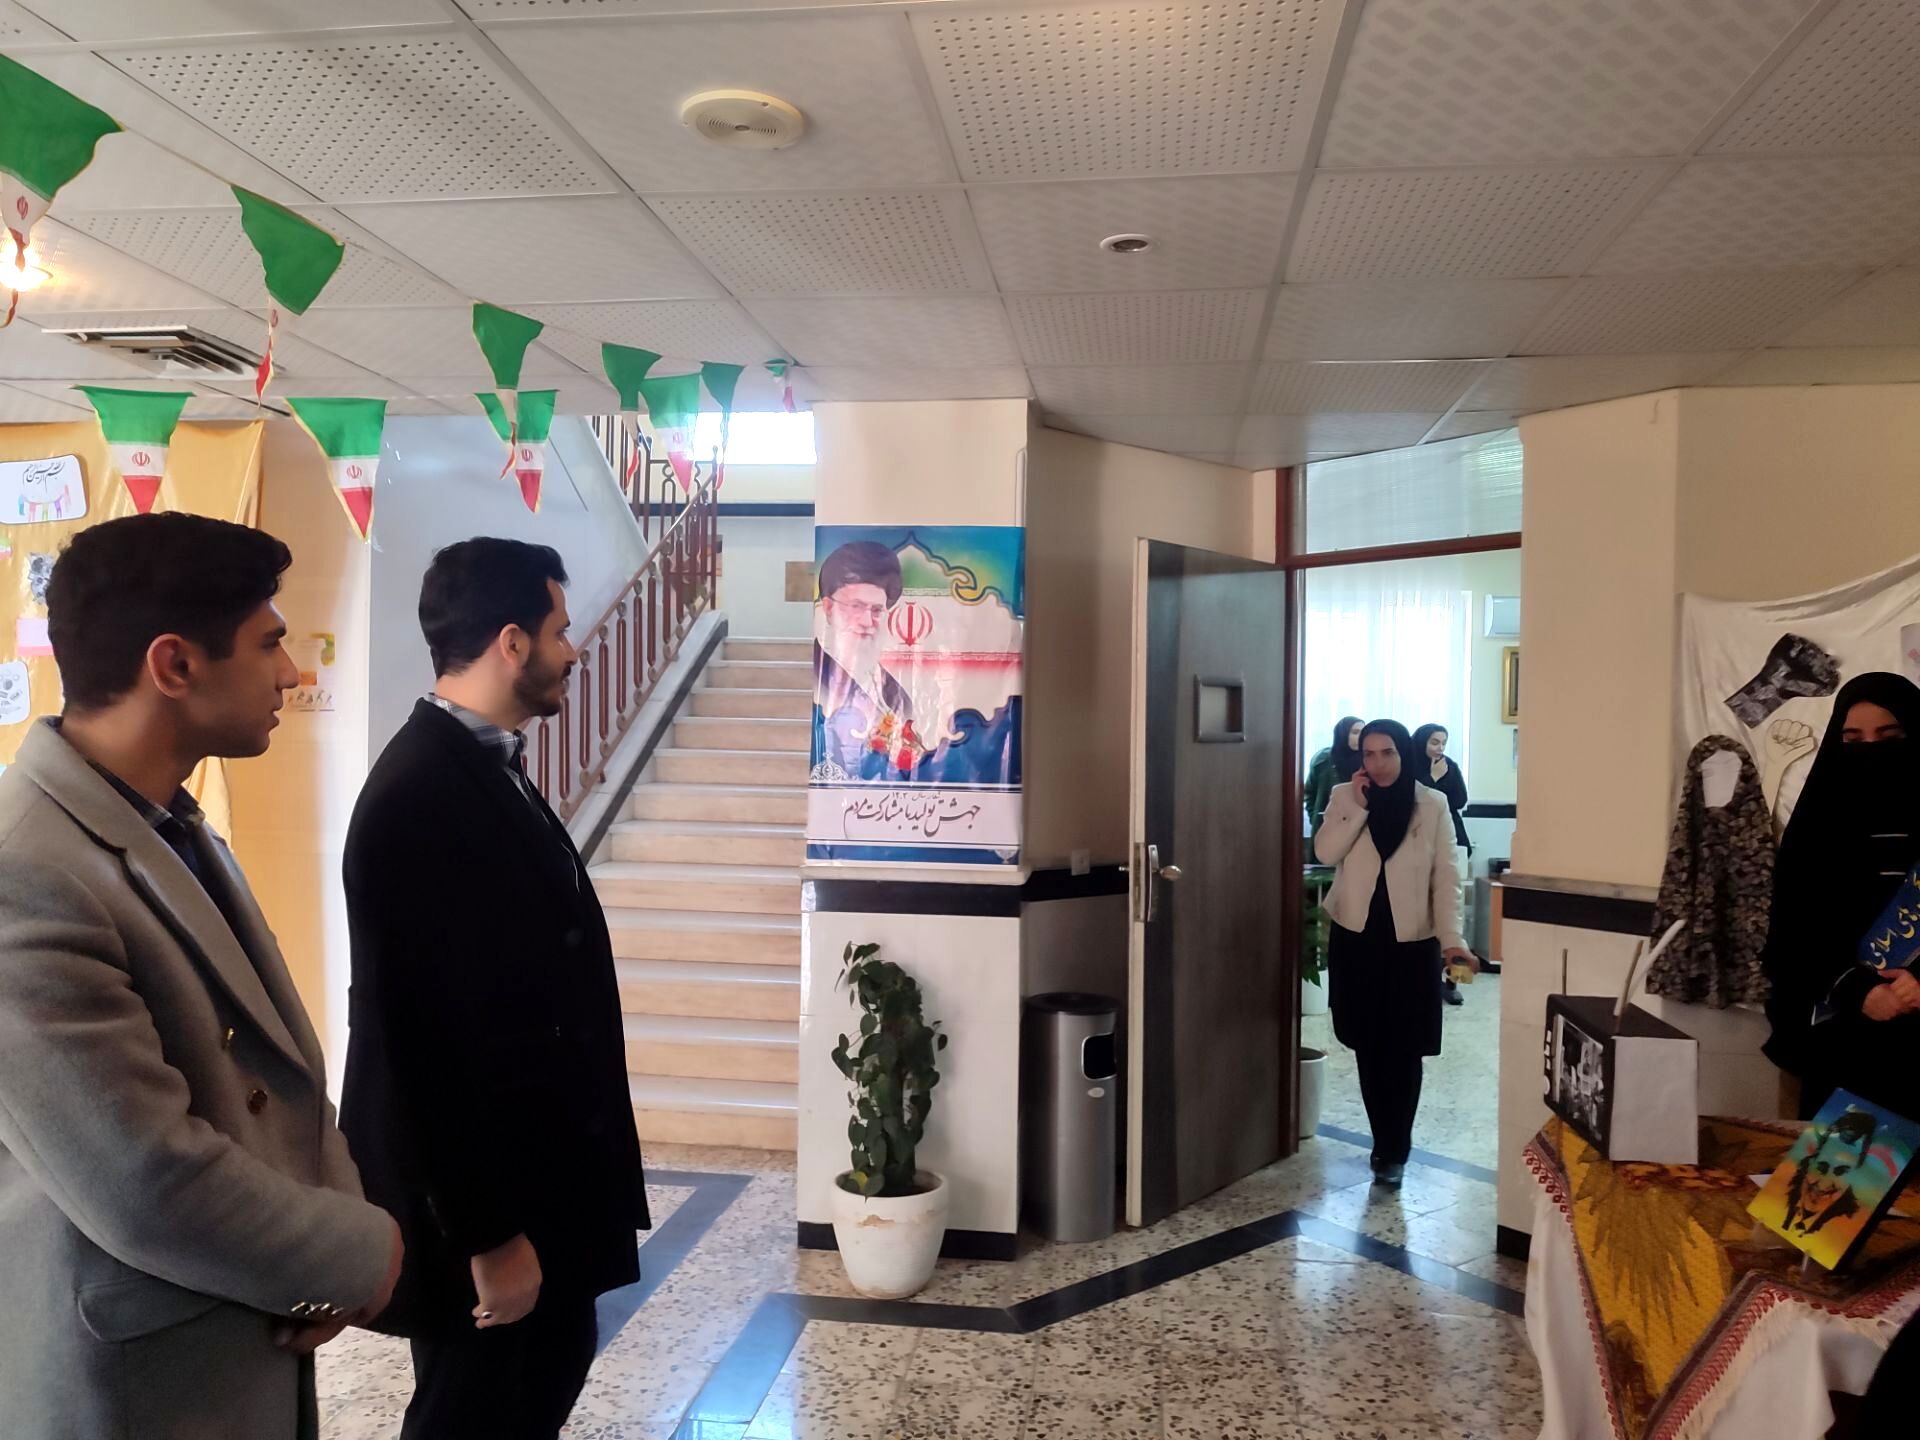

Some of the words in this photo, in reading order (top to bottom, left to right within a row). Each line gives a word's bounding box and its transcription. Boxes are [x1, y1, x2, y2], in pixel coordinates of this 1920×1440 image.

[843, 797, 868, 840] مردم
[856, 793, 903, 822] مشارکت
[908, 799, 944, 831] تولید
[924, 797, 981, 838] جهش
